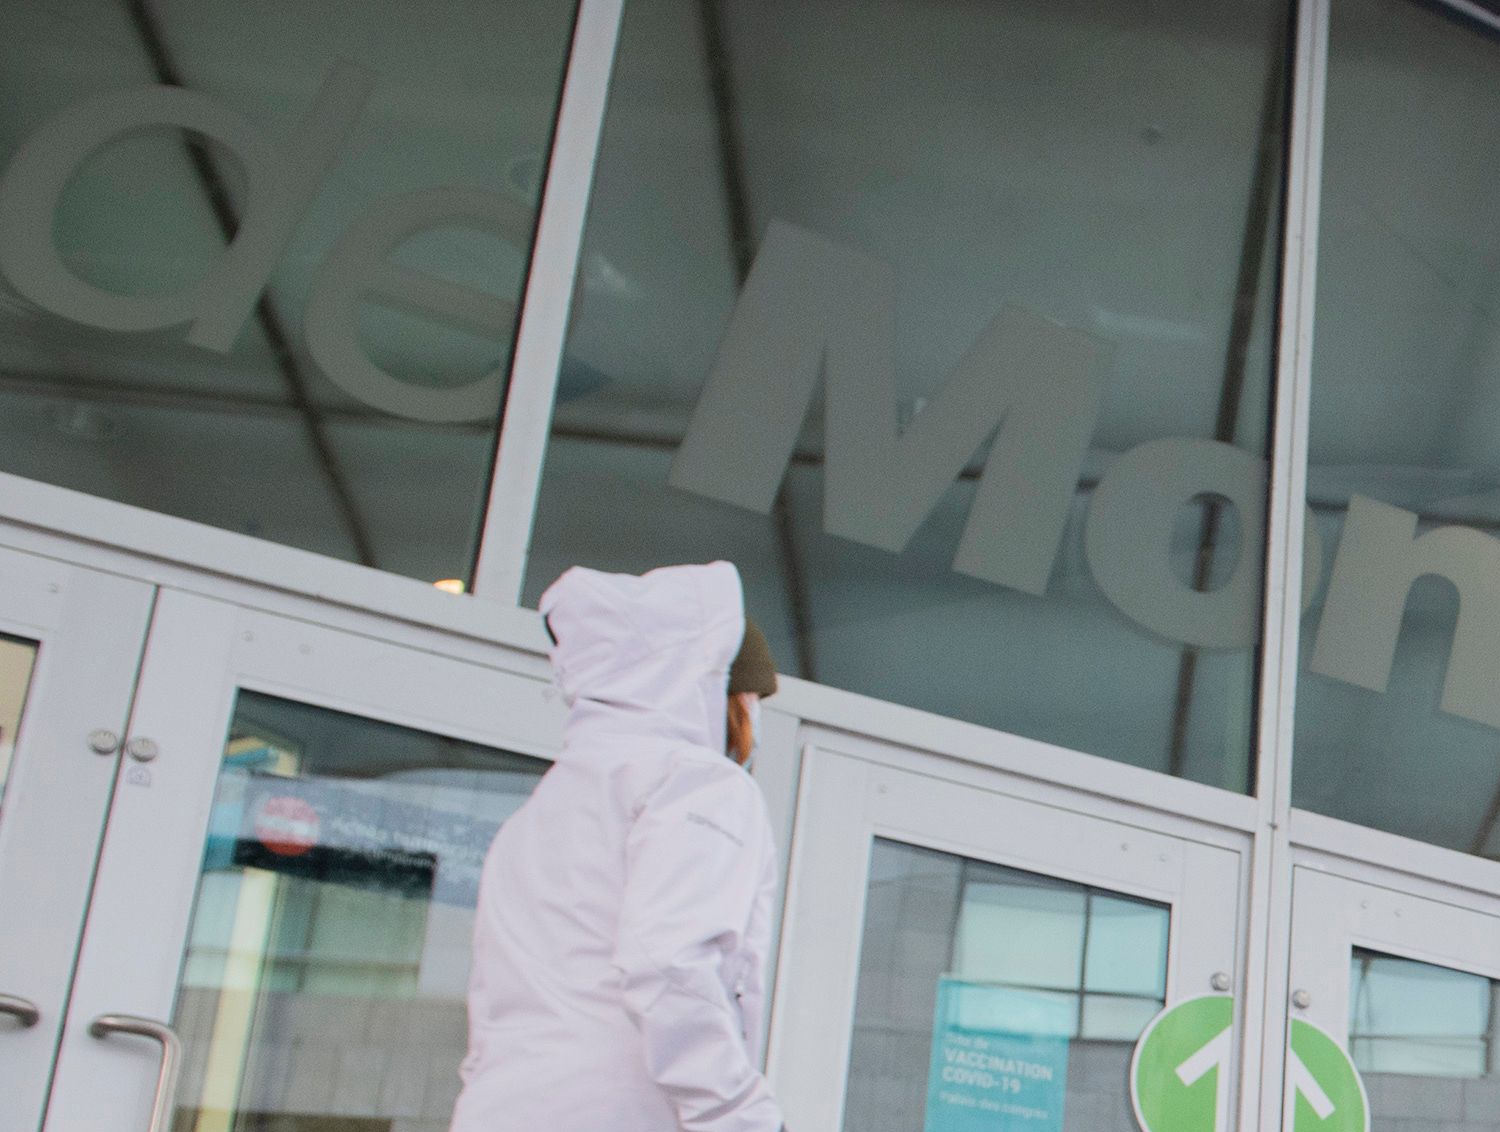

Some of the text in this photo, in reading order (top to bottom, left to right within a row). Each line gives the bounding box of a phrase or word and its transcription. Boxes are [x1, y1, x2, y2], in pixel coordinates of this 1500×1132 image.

[0, 56, 584, 424] de
[942, 1066, 1022, 1095] COVID-19
[944, 1048, 1053, 1081] VACCINATION
